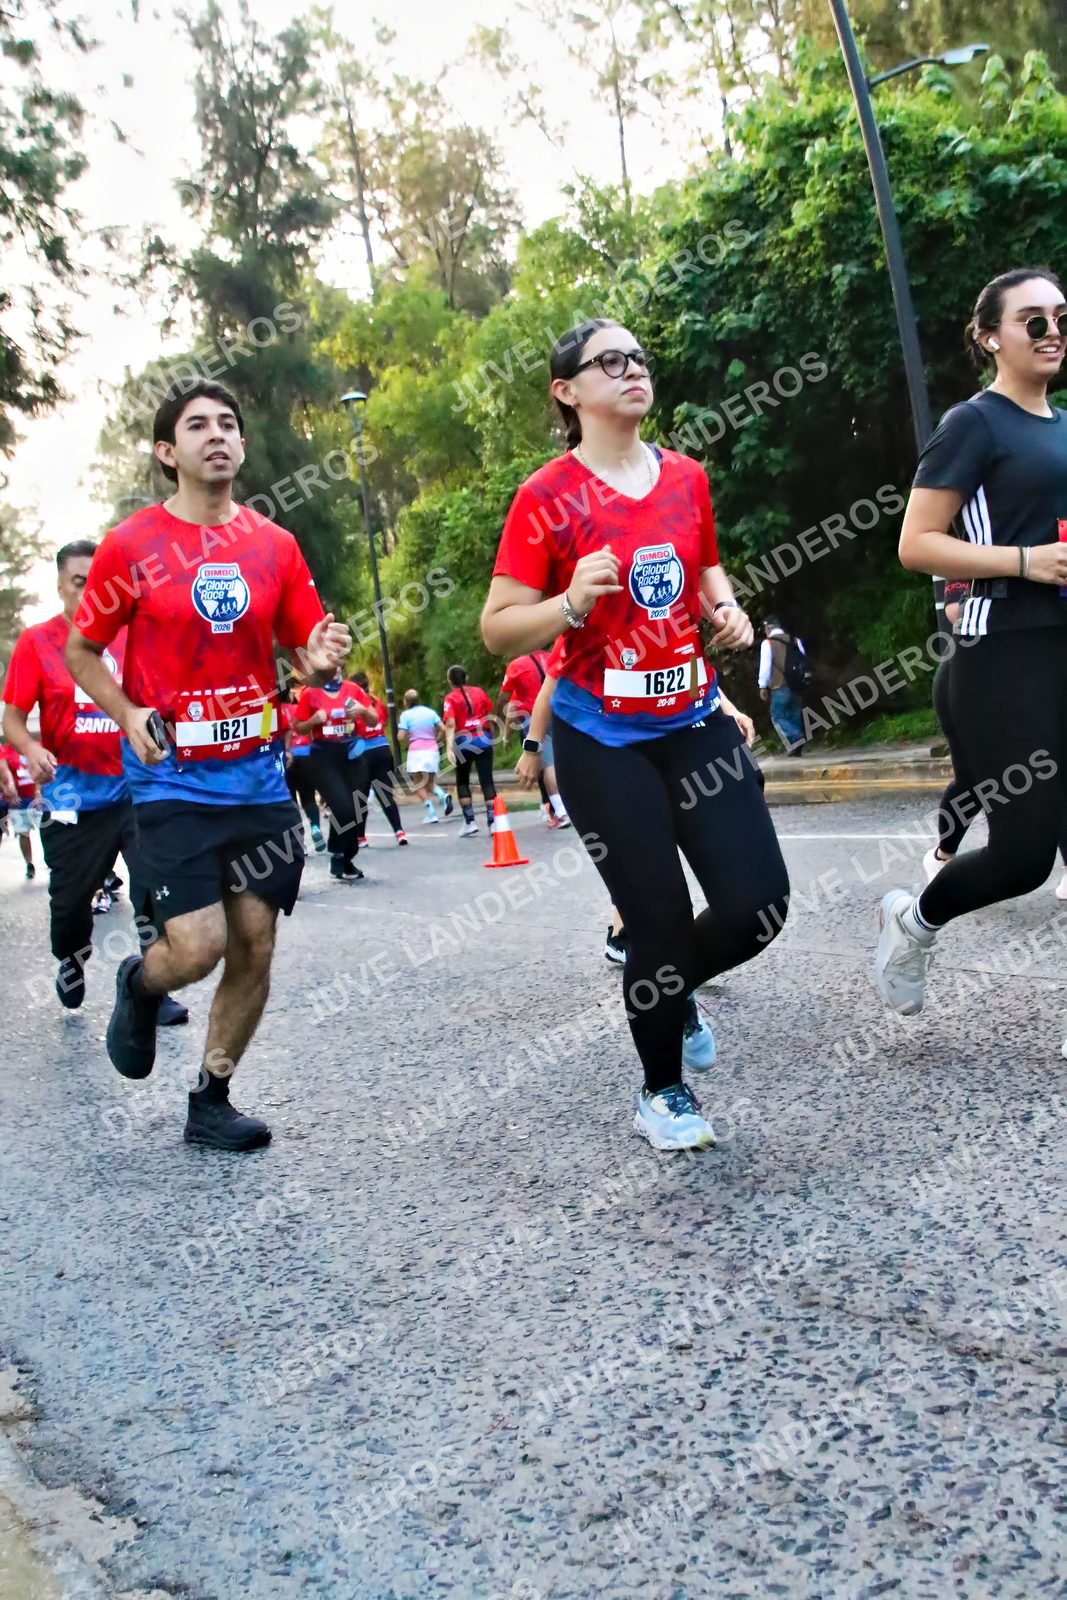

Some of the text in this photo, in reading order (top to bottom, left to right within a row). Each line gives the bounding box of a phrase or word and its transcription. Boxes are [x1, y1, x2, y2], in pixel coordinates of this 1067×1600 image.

[639, 550, 670, 561] BIMBO
[204, 569, 235, 577] BIMBO
[642, 561, 671, 577] Global
[205, 580, 235, 591] Global
[638, 574, 660, 588] Race
[201, 590, 225, 600] Race
[650, 608, 668, 618] 2026
[213, 624, 231, 632] 2026
[644, 666, 686, 696] 1622
[211, 717, 248, 742] 1621
